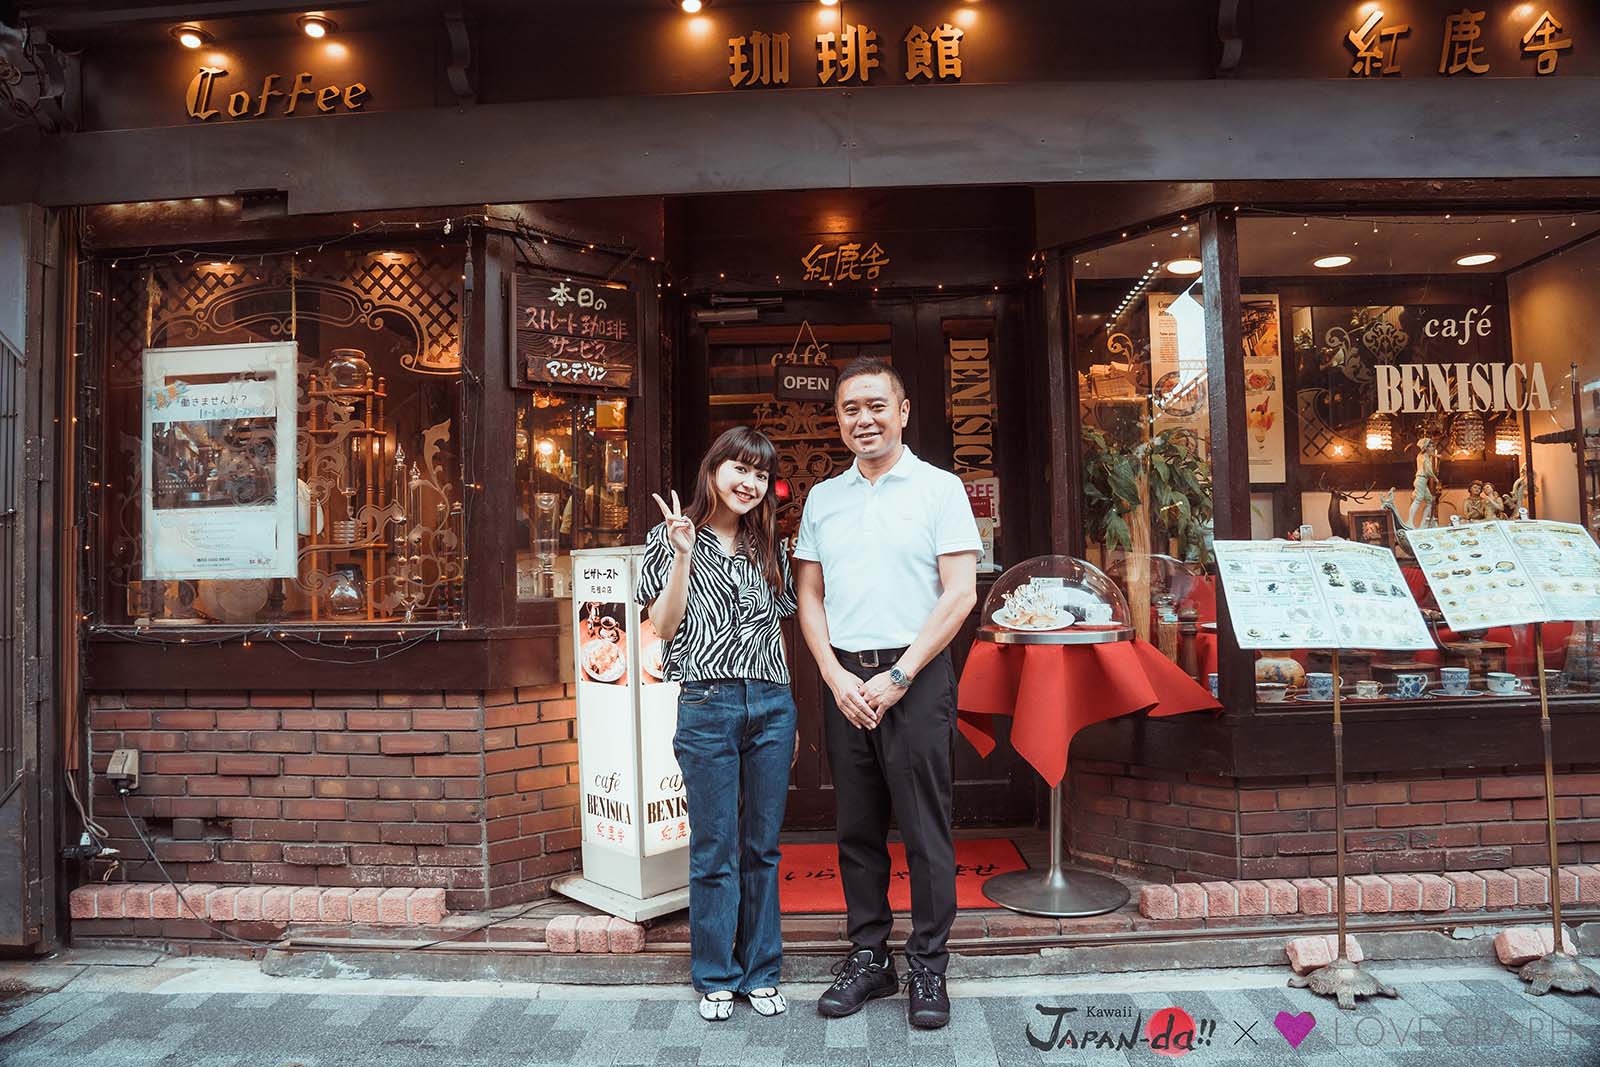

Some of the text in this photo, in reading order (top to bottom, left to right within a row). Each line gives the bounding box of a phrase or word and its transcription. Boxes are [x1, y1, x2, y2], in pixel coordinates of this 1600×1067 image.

[728, 24, 964, 88] 珈琲館
[1346, 9, 1573, 76] 紅鹿舎
[186, 66, 367, 120] Coffee
[801, 242, 890, 281] 紅鹿舎
[547, 282, 607, 311] 本日の
[1424, 304, 1493, 346] café
[548, 336, 607, 360] サービス
[546, 361, 608, 381] マンデリン
[783, 375, 830, 391] OPEN
[1374, 361, 1554, 414] BENISICA
[949, 337, 993, 481] BENISICA
[583, 568, 619, 580] ピザトースト
[594, 772, 622, 794] café
[587, 793, 632, 825] BENISICA
